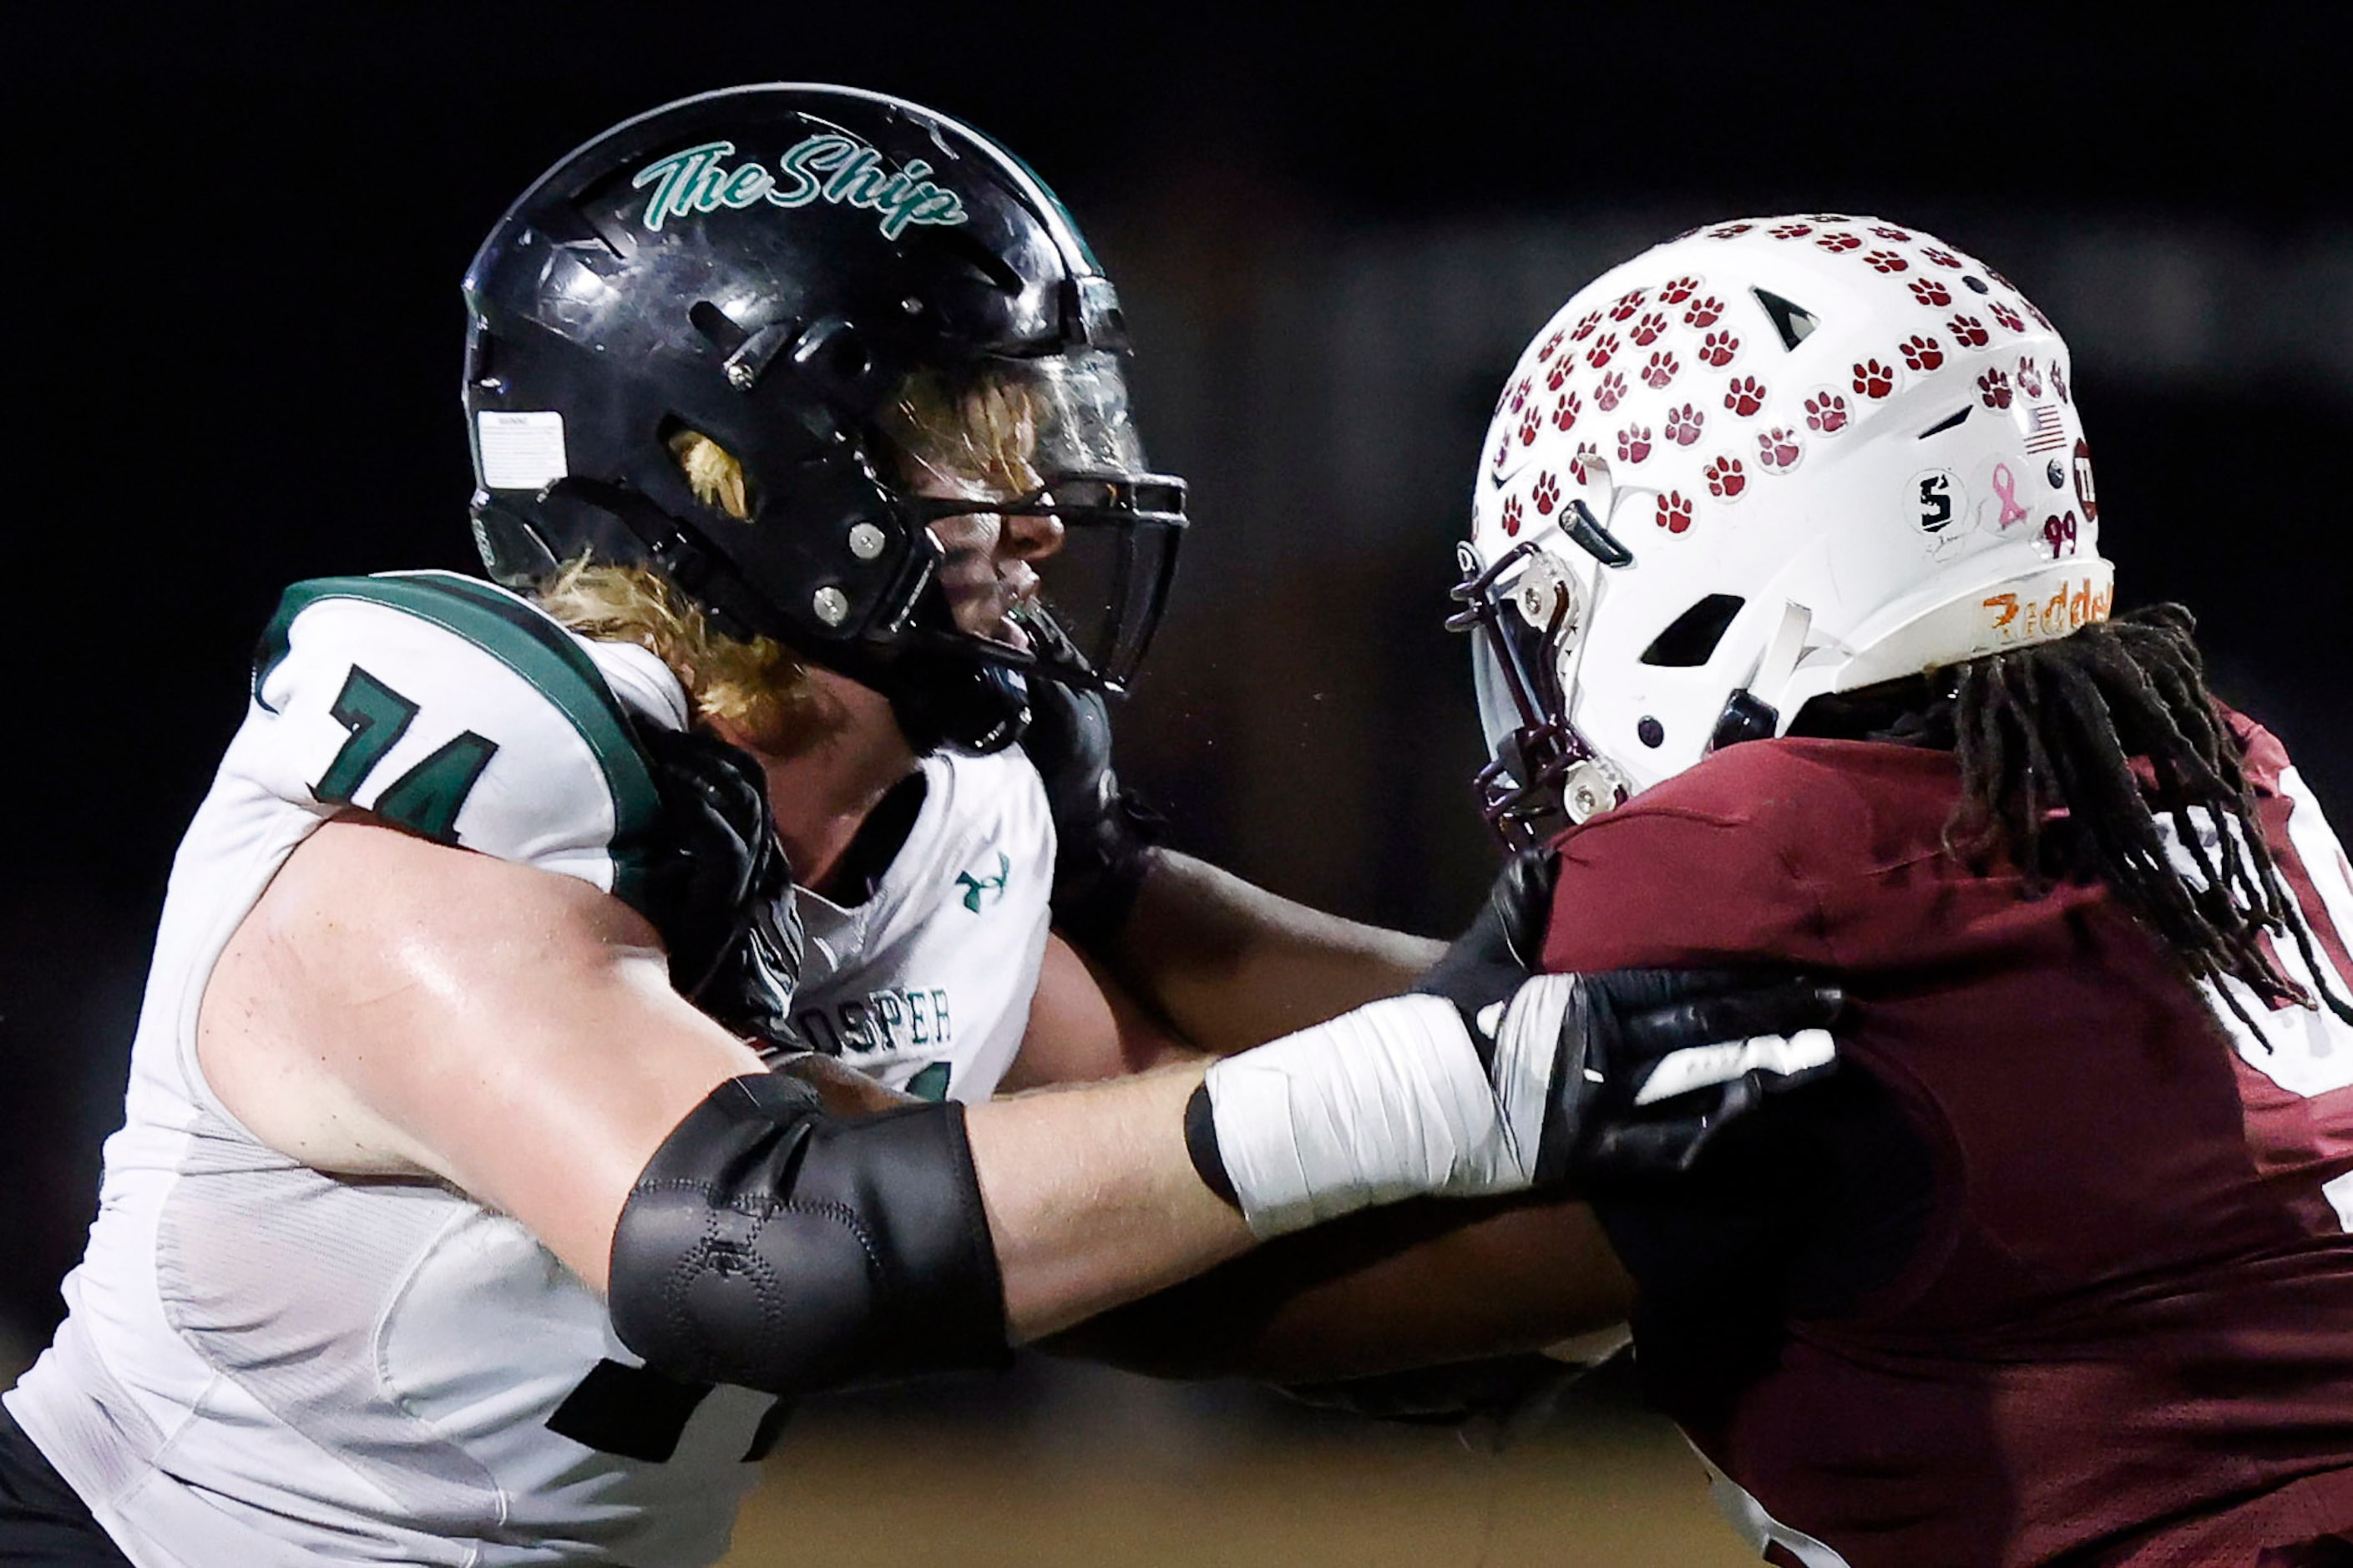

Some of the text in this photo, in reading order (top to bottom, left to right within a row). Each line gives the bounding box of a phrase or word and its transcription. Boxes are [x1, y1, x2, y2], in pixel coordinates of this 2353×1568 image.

[632, 134, 968, 241] The Ship
[2044, 510, 2077, 559] 99
[306, 663, 500, 846] 74
